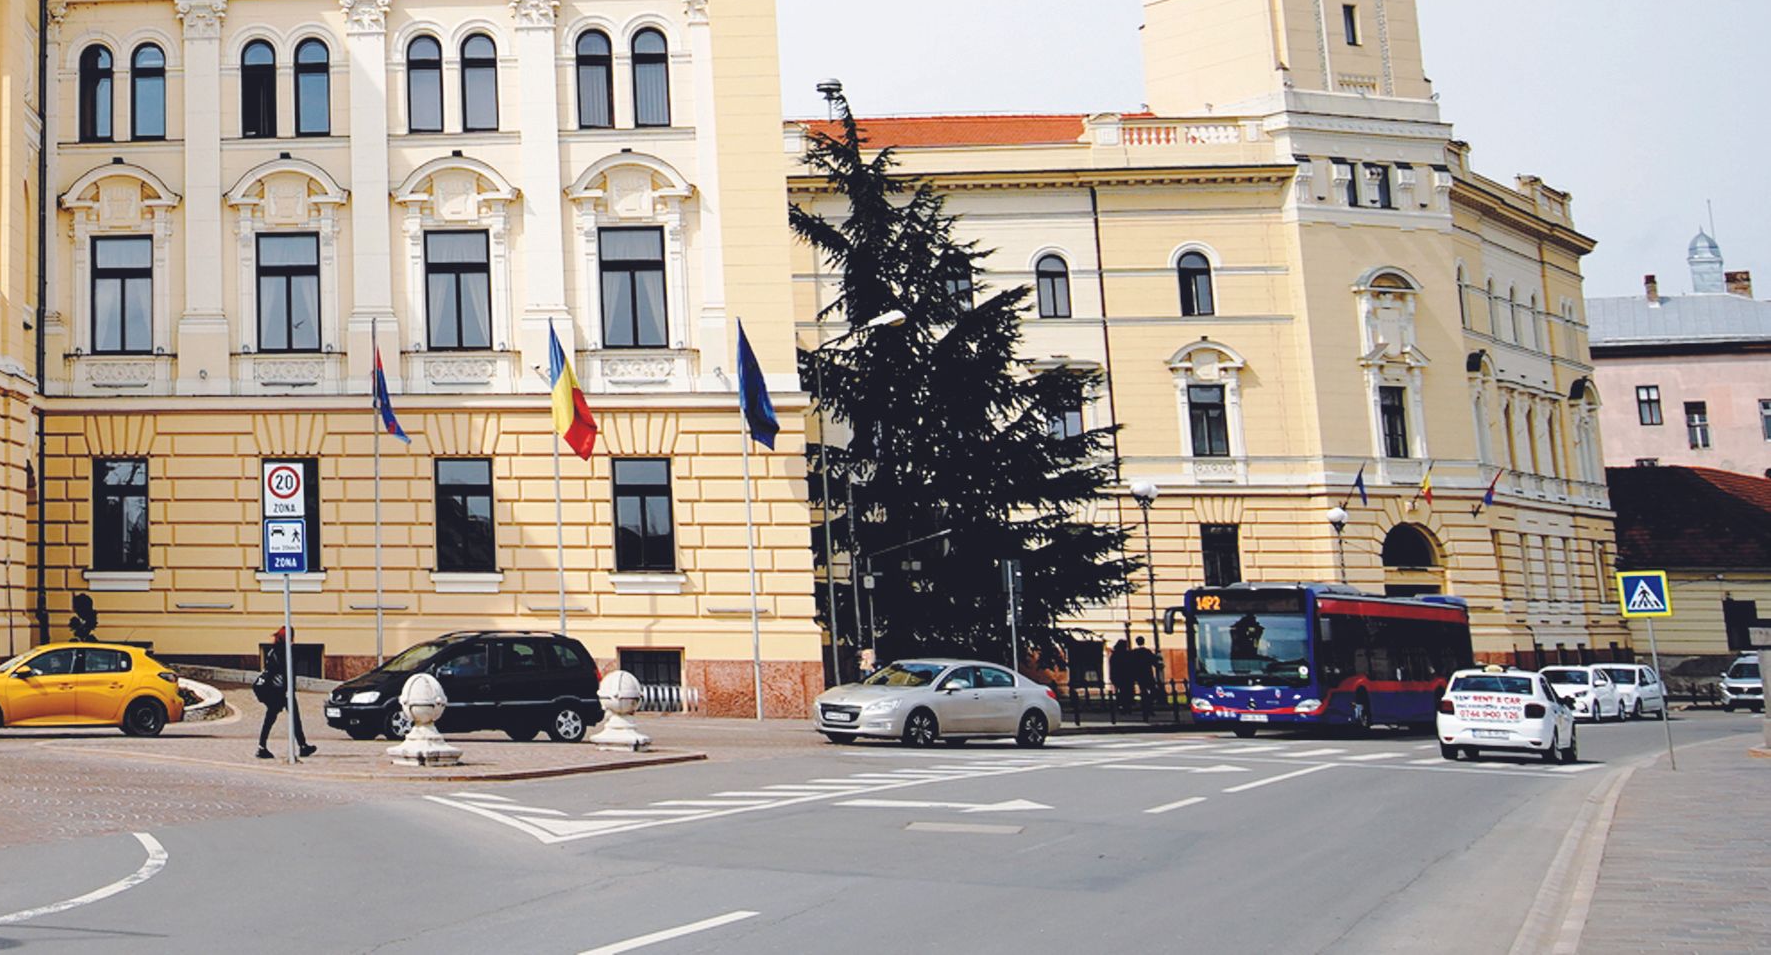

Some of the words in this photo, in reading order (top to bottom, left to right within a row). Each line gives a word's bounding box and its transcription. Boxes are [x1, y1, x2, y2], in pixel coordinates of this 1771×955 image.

[275, 474, 294, 490] 20
[273, 503, 296, 513] ZONA
[274, 557, 298, 568] ZONA
[1504, 697, 1521, 705] CAR
